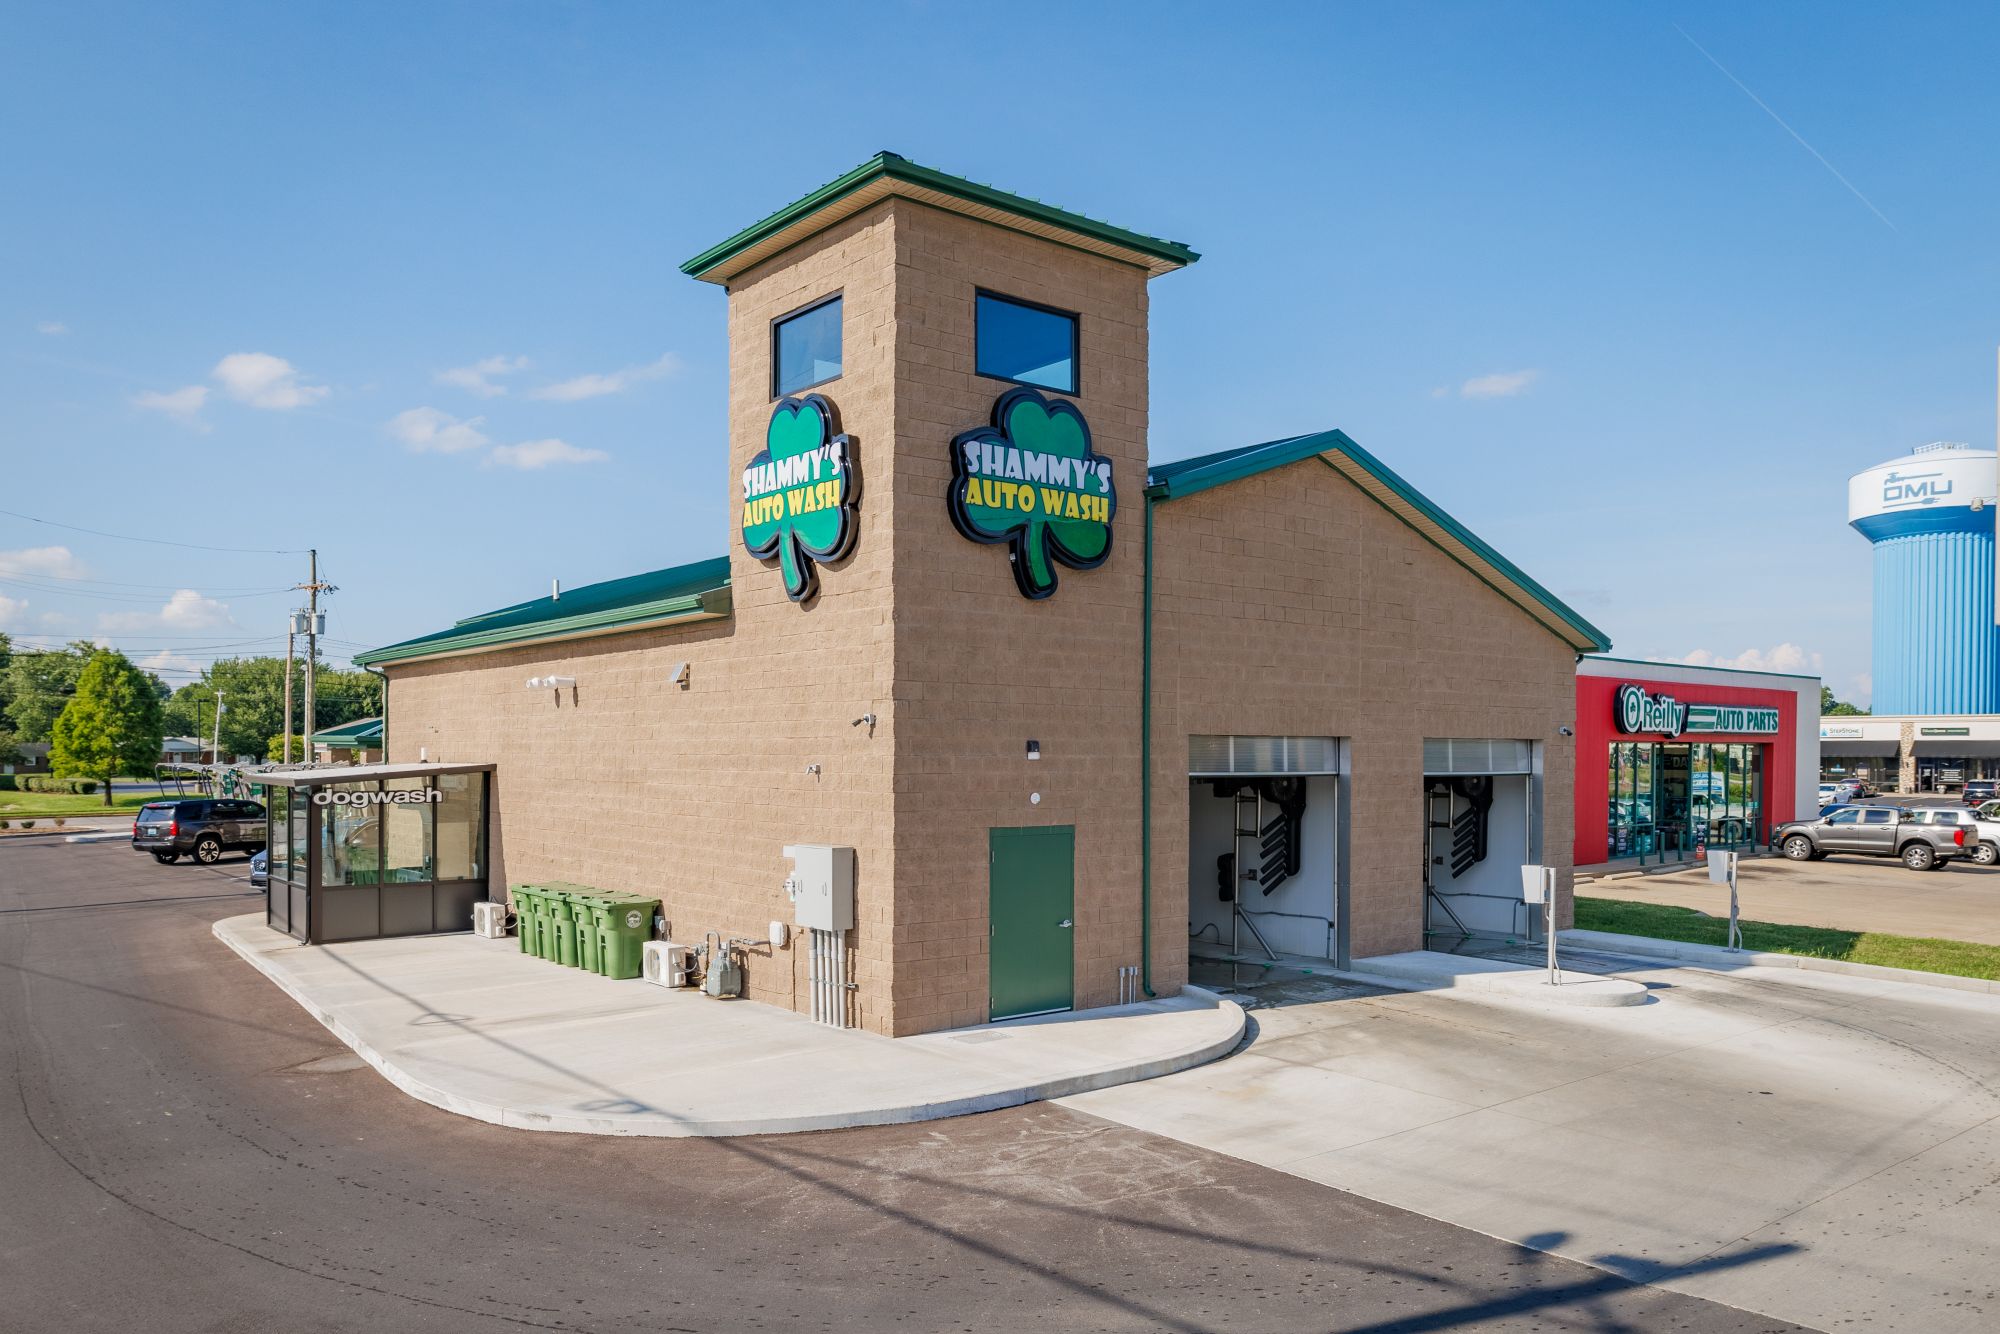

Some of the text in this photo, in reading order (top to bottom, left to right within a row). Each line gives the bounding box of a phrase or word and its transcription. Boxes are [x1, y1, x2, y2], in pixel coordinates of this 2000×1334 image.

[743, 442, 842, 498] SHAMMY'S
[965, 441, 1111, 493] SHAMMY'S
[743, 479, 840, 527] AUTO WASH
[965, 478, 1110, 523] AUTO WASH
[1884, 480, 1953, 501] OMU
[1625, 690, 1778, 732] O'Reilly AUTO PARTS
[313, 787, 443, 808] dogwash
